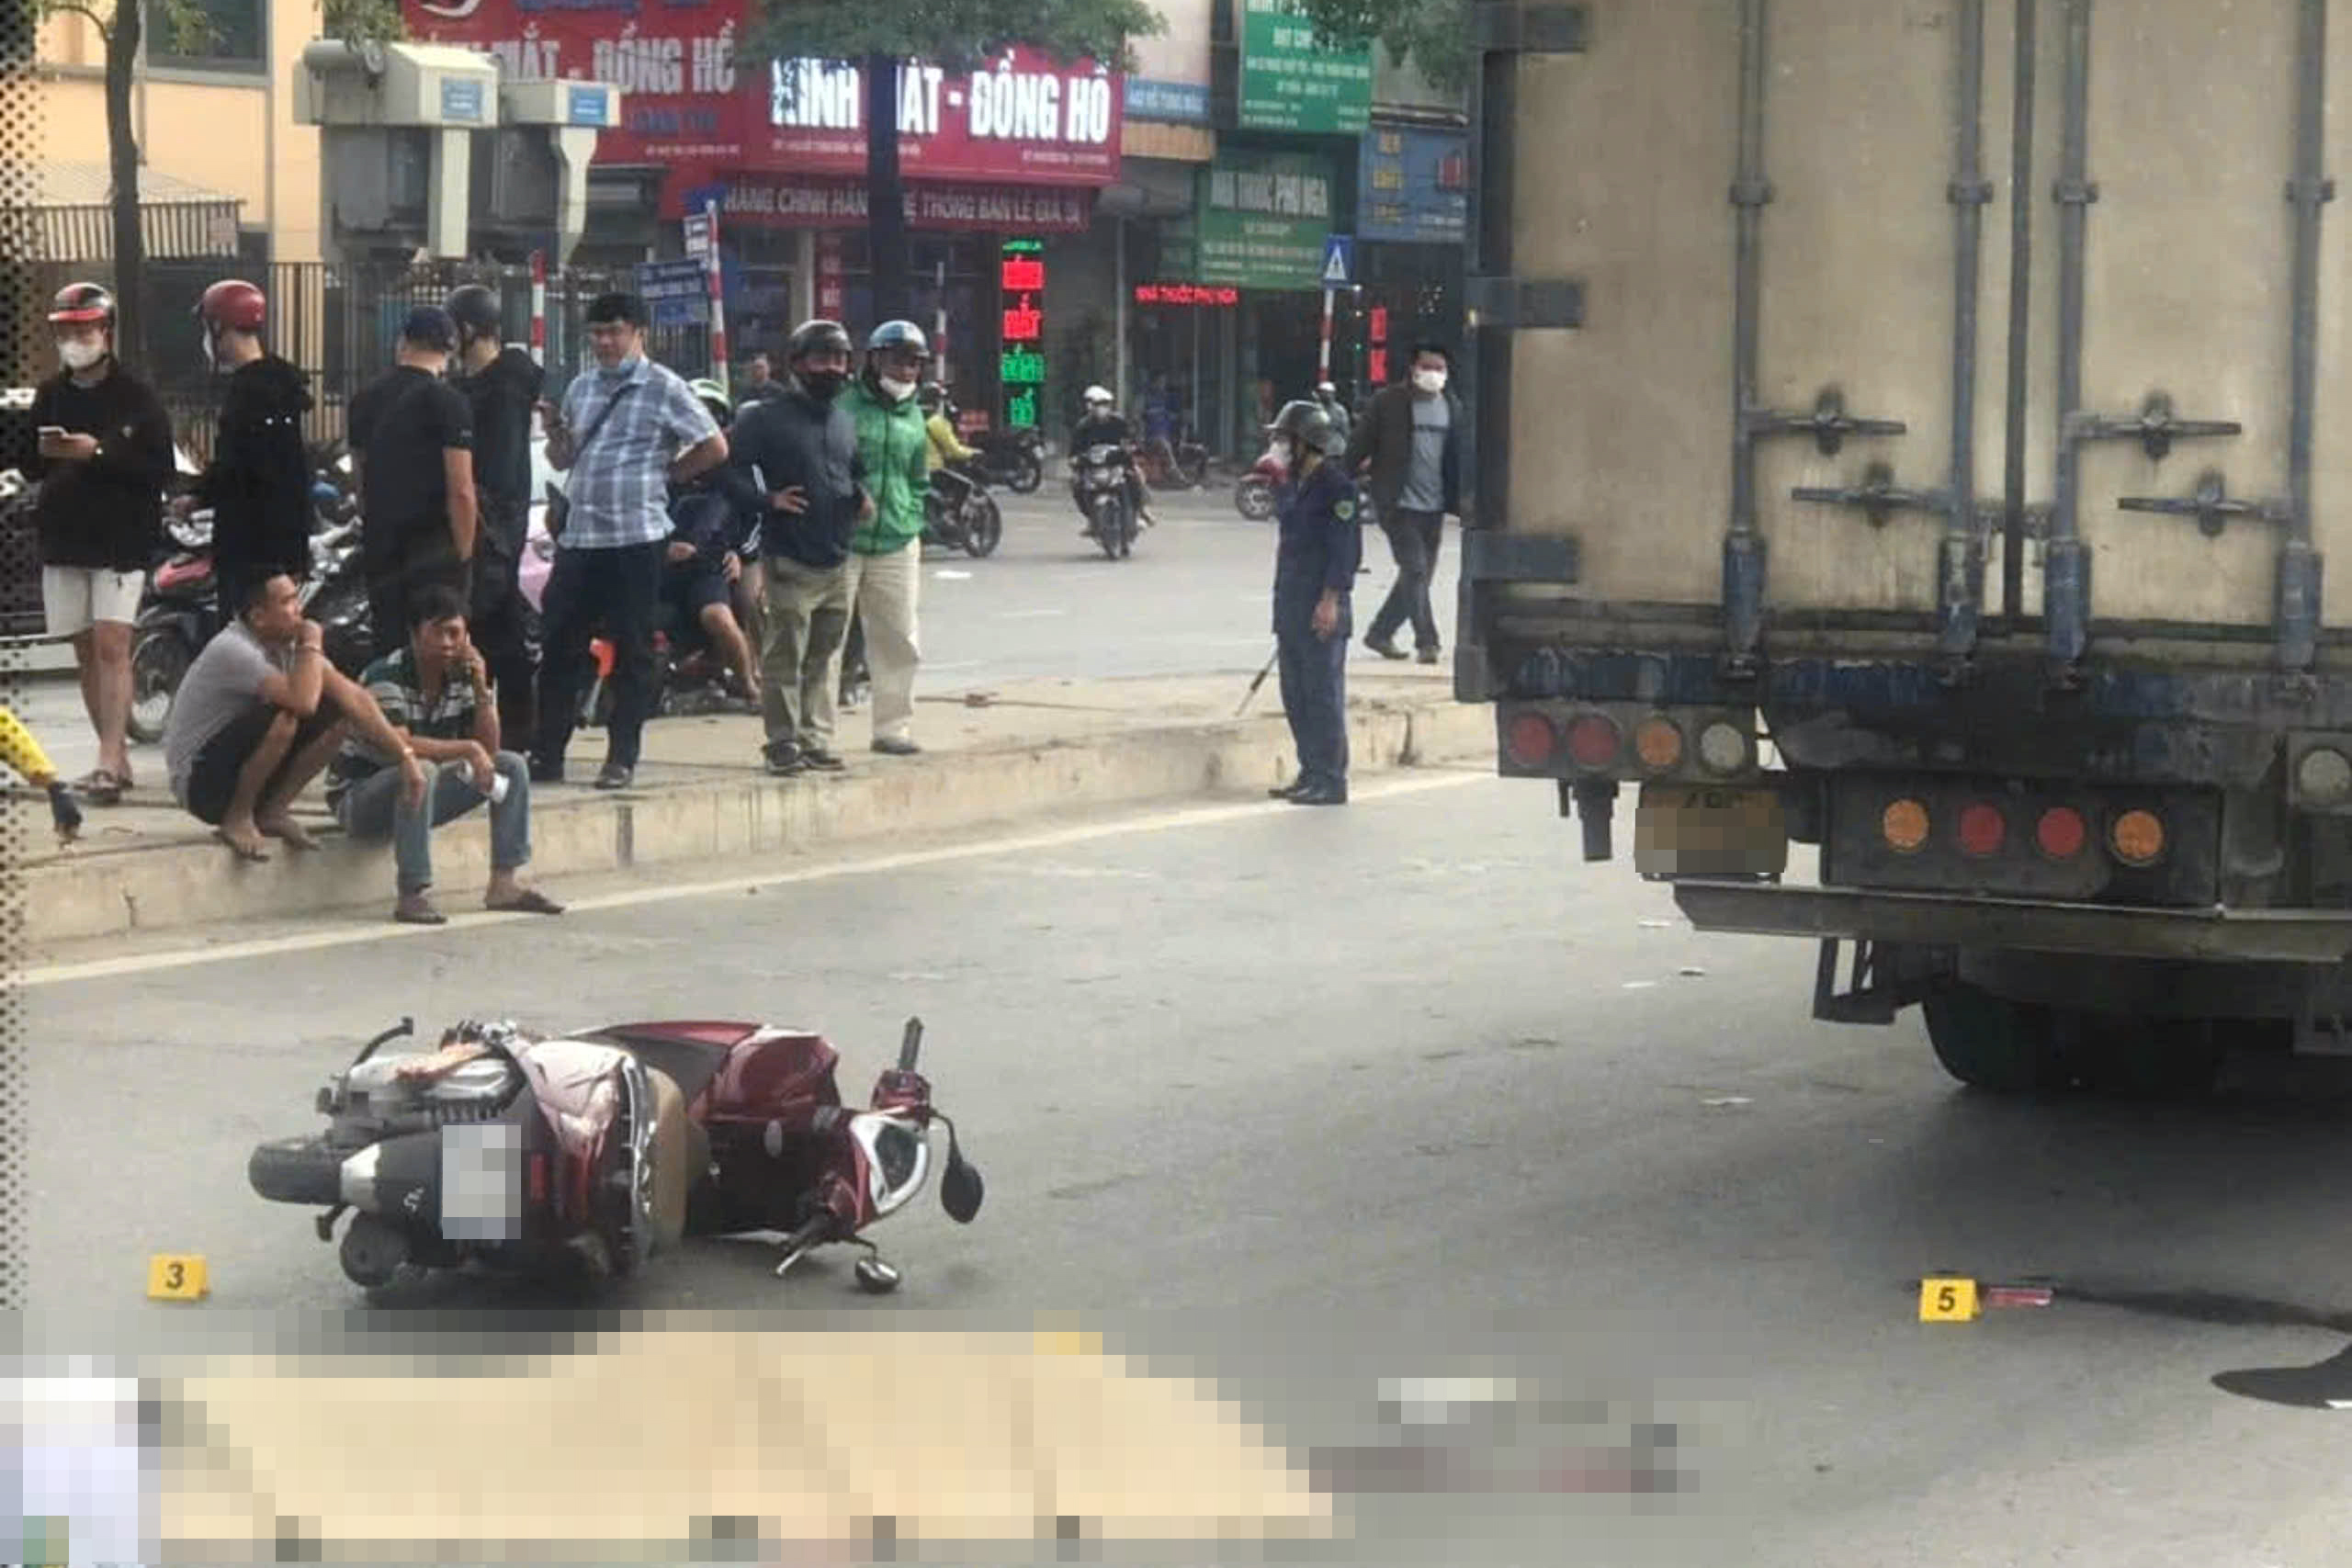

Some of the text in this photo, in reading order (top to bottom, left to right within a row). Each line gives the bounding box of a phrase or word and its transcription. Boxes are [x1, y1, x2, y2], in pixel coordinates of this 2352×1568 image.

[970, 48, 1060, 140] ĐỒNG
[165, 1261, 186, 1291] 3
[1937, 1285, 1957, 1313] 5
